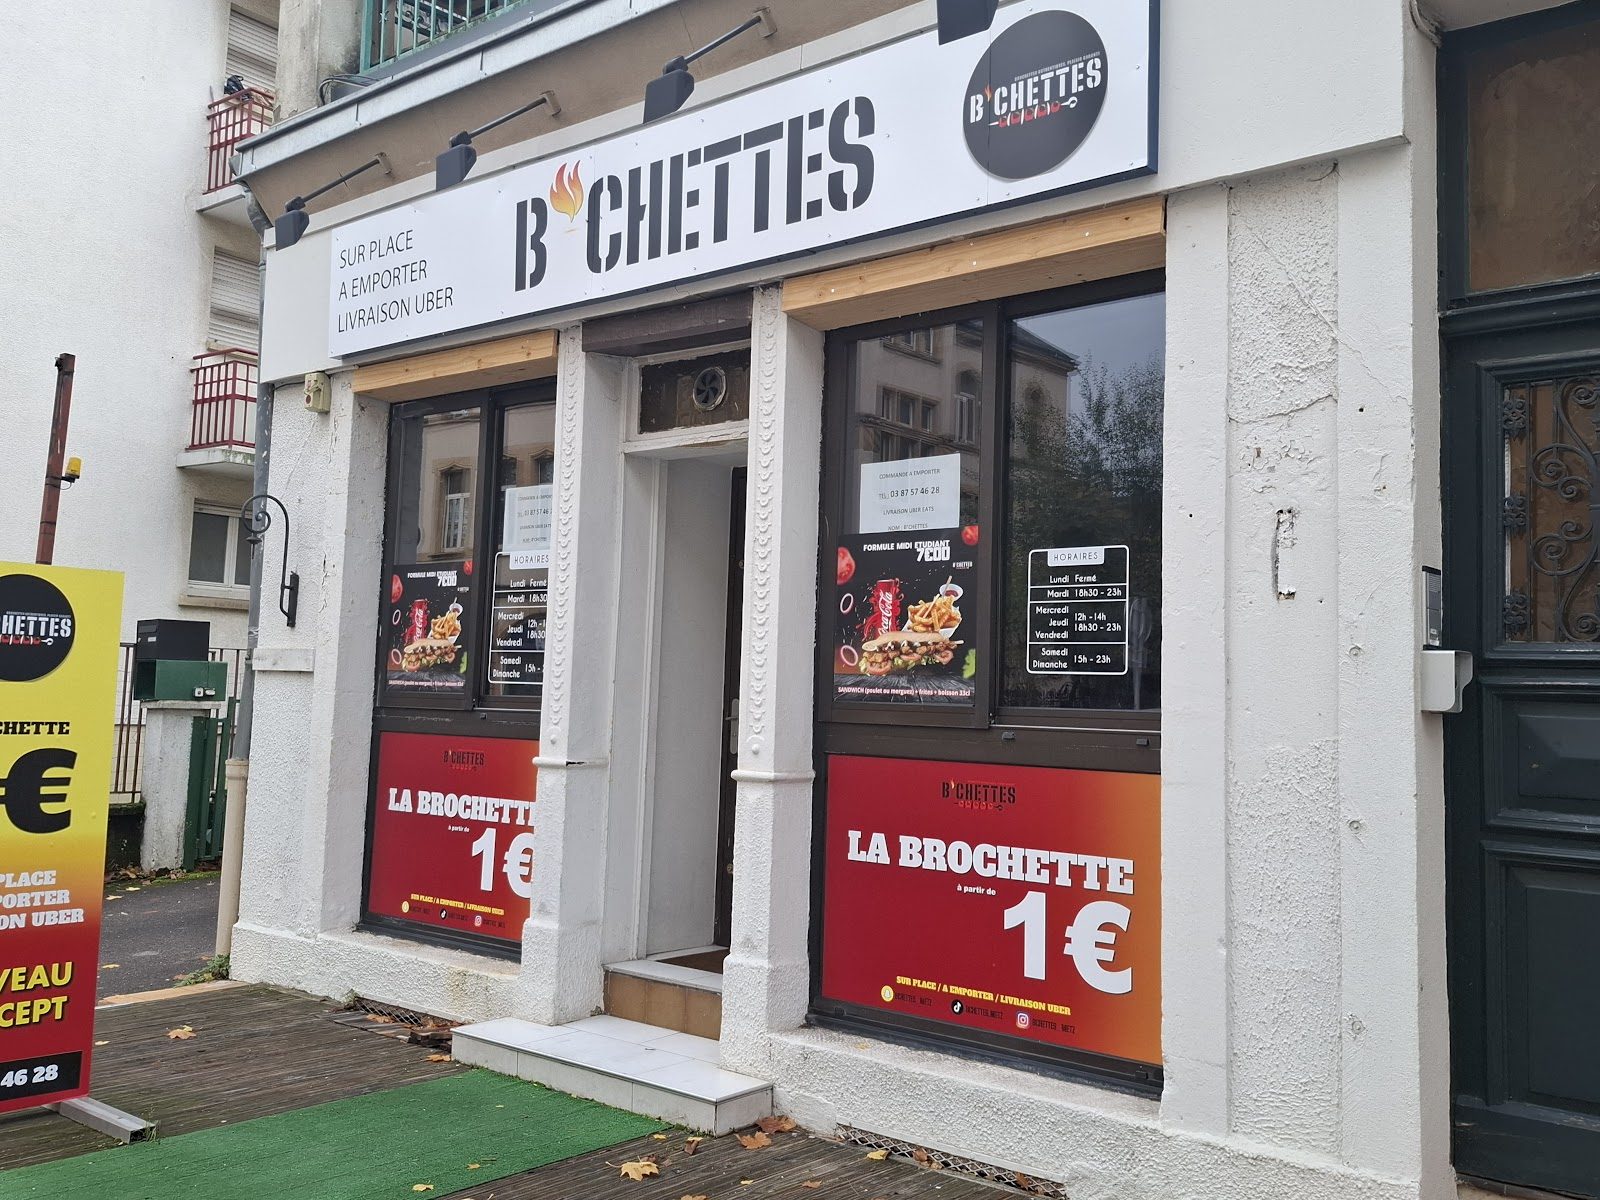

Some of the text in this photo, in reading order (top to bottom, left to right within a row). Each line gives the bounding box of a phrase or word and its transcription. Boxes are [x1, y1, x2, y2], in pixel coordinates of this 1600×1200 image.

[339, 230, 413, 269] SUR PLACE
[339, 260, 427, 301] A EMPORTER
[338, 287, 453, 333] LIVRAISON UBER
[911, 488, 918, 496] 57
[931, 486, 940, 494] 28
[863, 540, 950, 551] FORMULE MIDI ETUDIANT
[514, 555, 549, 564] HORAIRES
[1053, 552, 1098, 562] HORAIRES
[510, 578, 547, 588] Lundi Fermé
[1049, 574, 1097, 583] Lundi Fermé
[1047, 589, 1069, 598] Mardi
[1075, 588, 1098, 597] 18h30
[1107, 588, 1121, 597] 23h
[507, 594, 547, 603] Mardi 18h30
[1035, 606, 1069, 614] Mercredi
[497, 611, 524, 620] Mercredi
[1074, 612, 1086, 621] 12h
[1094, 612, 1106, 621] 14h
[0, 615, 71, 637] HETTES
[527, 619, 537, 628] 12h
[1049, 618, 1069, 627] Jeudi
[507, 625, 523, 633] Jeudi
[1074, 623, 1098, 632] 18h30
[1106, 623, 1121, 632] 23h
[527, 630, 546, 639] 18h30
[1035, 631, 1069, 639] Vendredi
[496, 638, 522, 646] Vendredi
[1041, 648, 1068, 656] Samedi
[500, 656, 521, 664] Samedi
[1033, 660, 1068, 668] Dimanche
[1074, 655, 1087, 663] 15h
[1096, 655, 1111, 664] 23h
[525, 663, 536, 672] 15h
[492, 669, 520, 678] Dimanche
[0, 721, 70, 735] HETTE
[388, 788, 413, 813] LA
[847, 830, 1134, 895] LA BROCHETTE
[957, 884, 996, 896] à partir de
[0, 889, 70, 909] ORTER
[32, 908, 84, 927] UBER
[896, 975, 911, 986] SUR
[912, 977, 936, 991] PLACE
[942, 984, 948, 993] A
[950, 985, 994, 1002] EMPORTER
[1000, 994, 1046, 1012] LIVRAISON
[1047, 1003, 1071, 1016] UBER
[0, 996, 67, 1028] CEPT
[0, 1064, 59, 1088] 46 28
